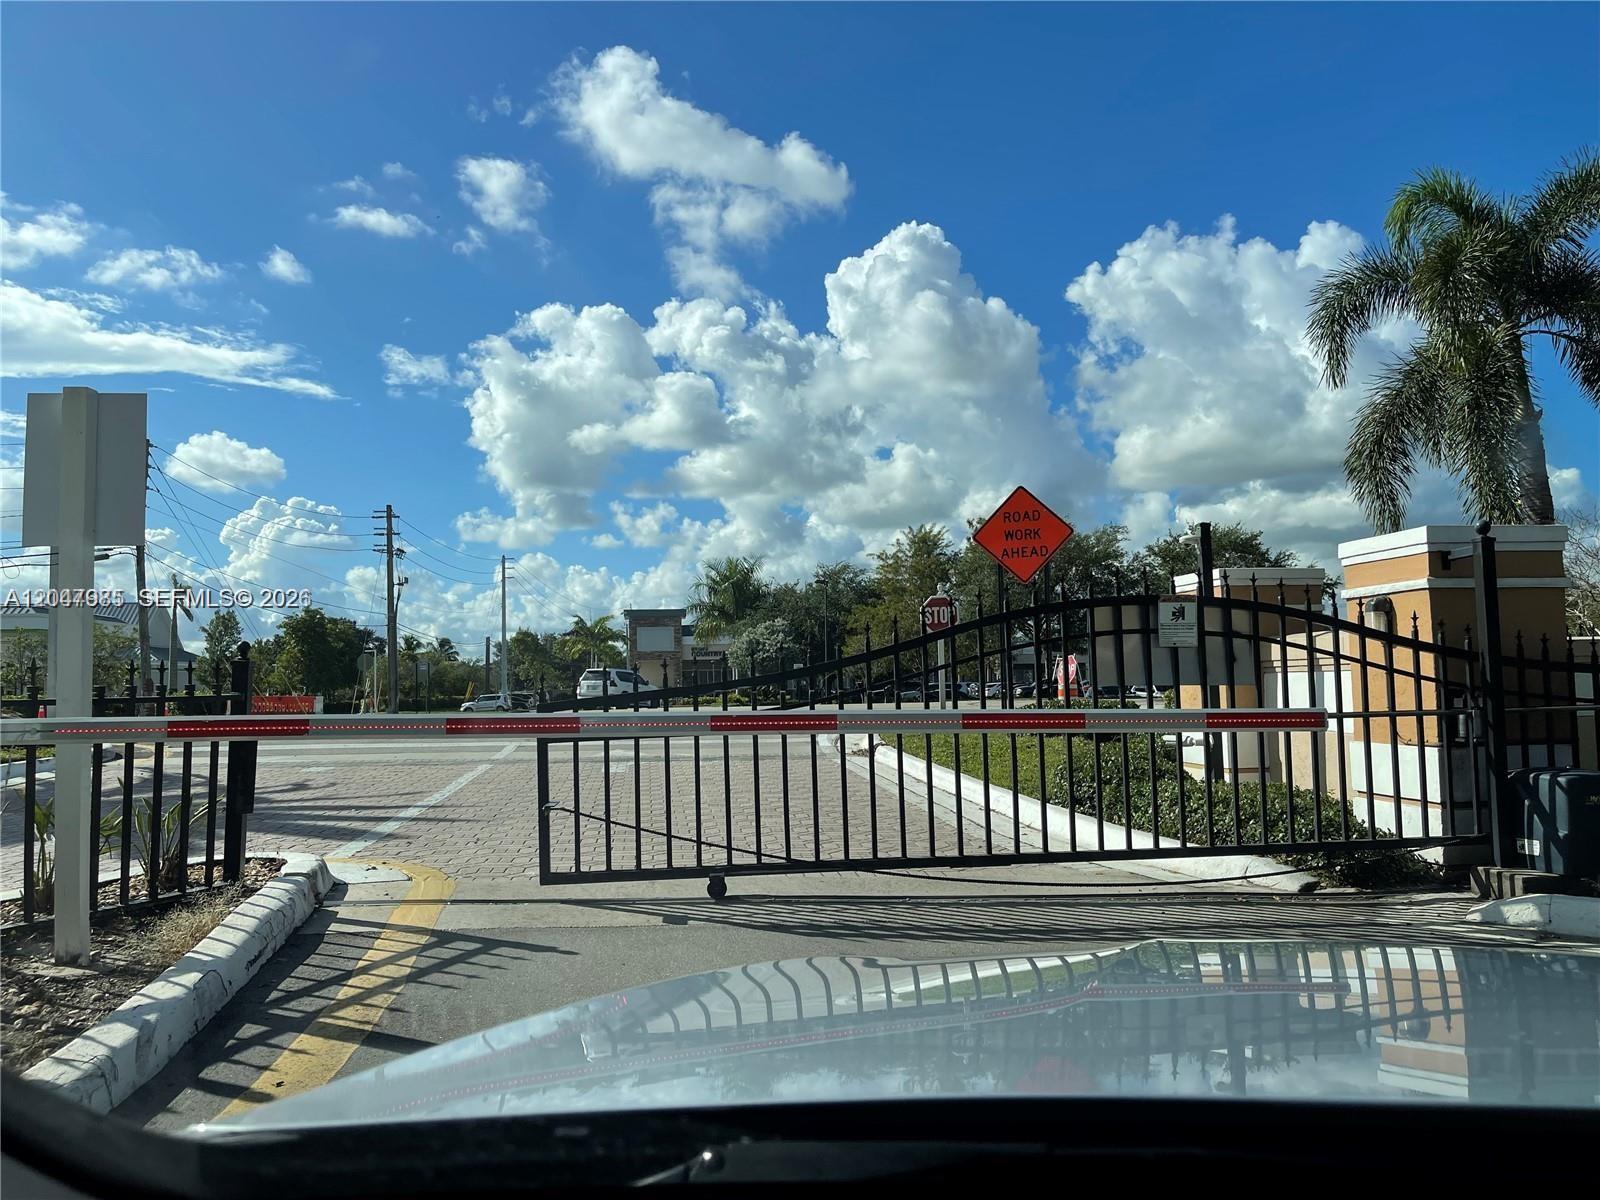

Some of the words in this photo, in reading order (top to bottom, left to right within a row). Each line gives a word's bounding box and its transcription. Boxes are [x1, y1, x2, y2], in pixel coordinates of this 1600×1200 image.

[1003, 510, 1041, 523] ROAD
[1004, 528, 1042, 541] WORK
[1001, 545, 1049, 559] AHEAD
